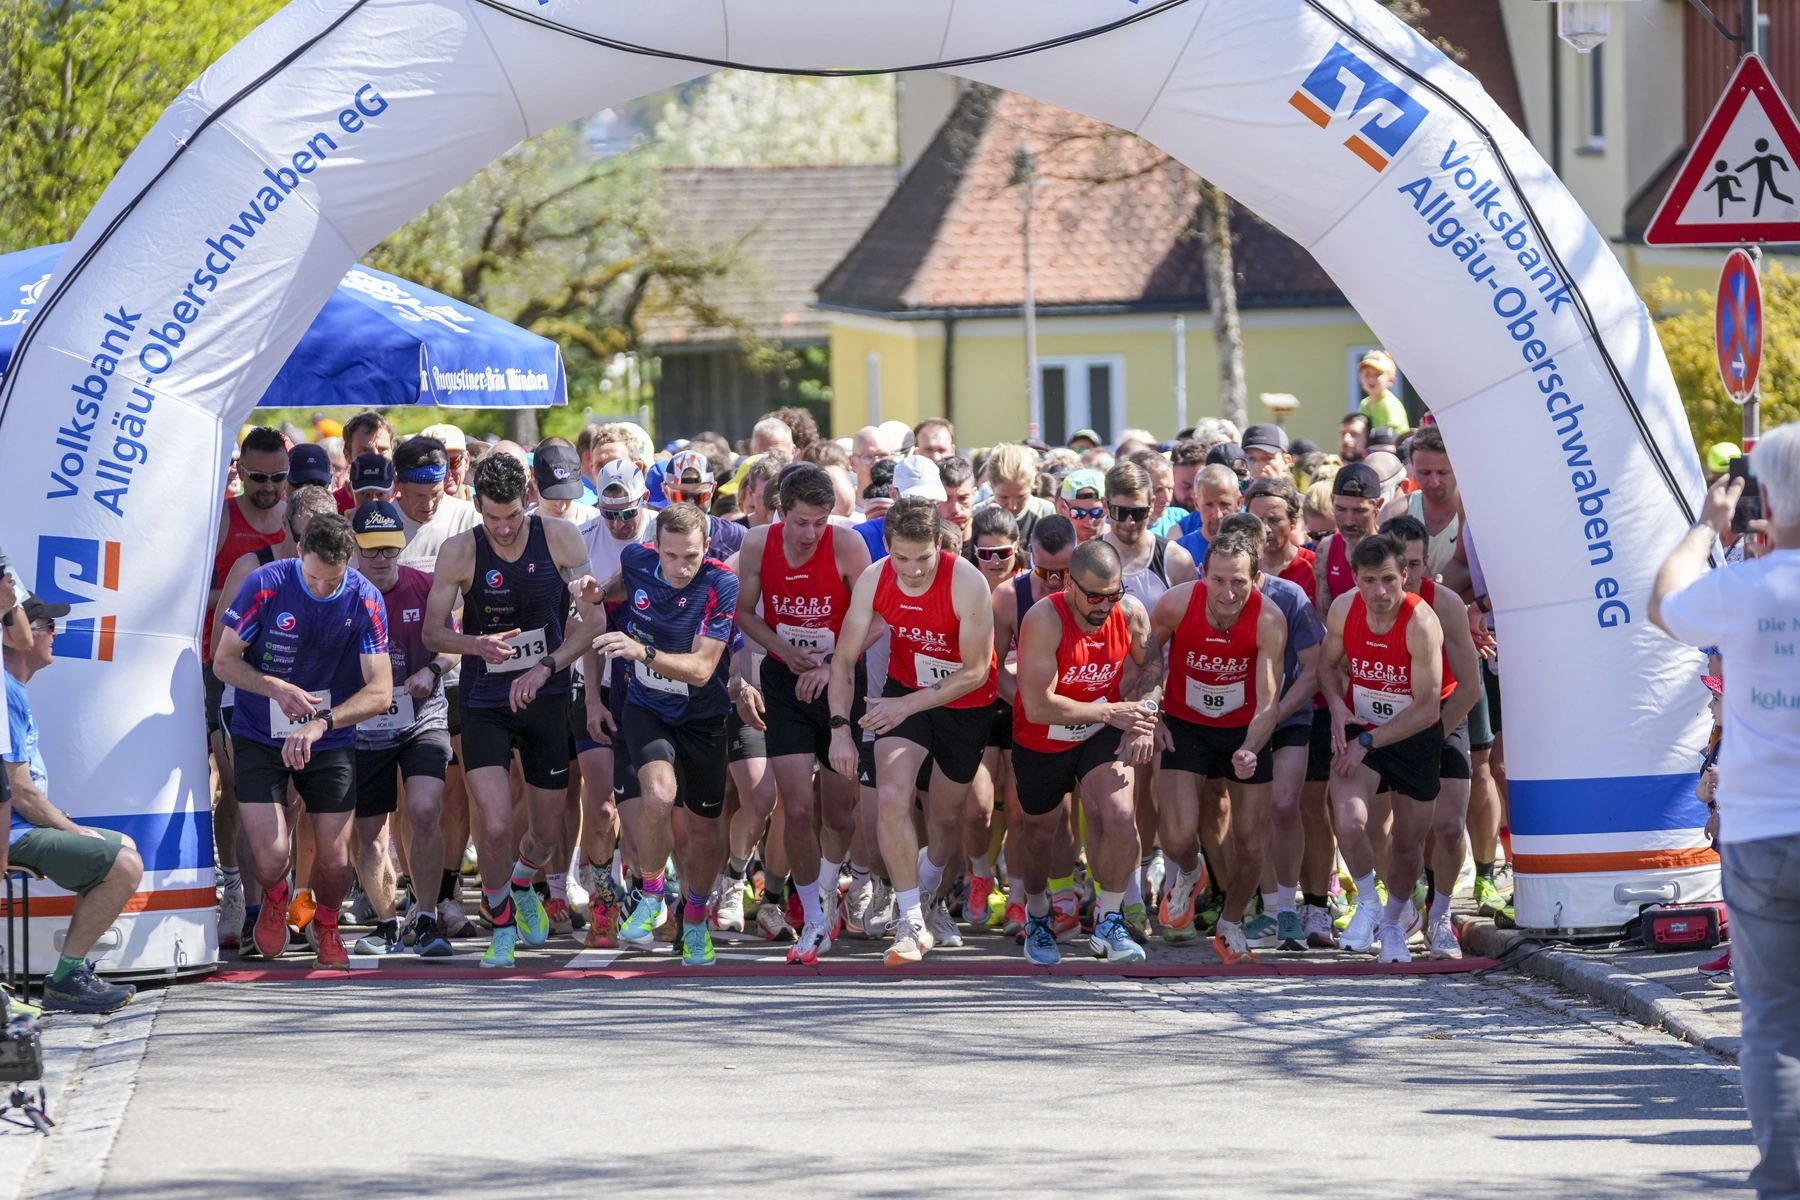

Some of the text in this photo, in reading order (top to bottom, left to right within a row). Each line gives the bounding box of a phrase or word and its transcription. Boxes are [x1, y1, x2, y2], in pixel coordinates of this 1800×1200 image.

[1438, 140, 1575, 315] Volksbank
[94, 131, 338, 517] Allgäu-Oberschwaben
[338, 83, 389, 135] eG
[47, 306, 142, 500] Volksbank
[1398, 176, 1631, 628] Allgäu-Oberschwaben eG
[772, 595, 831, 607] SPORT
[1757, 617, 1786, 632] Die
[1774, 640, 1795, 655] ist
[1186, 658, 1248, 672] HASCHKO
[1187, 651, 1250, 665] SPORT
[930, 667, 956, 678] 10
[1067, 660, 1121, 676] SPORT
[1352, 658, 1406, 675] SPORT
[1352, 667, 1407, 683] HASCHKO
[379, 700, 399, 715] 6
[1203, 694, 1225, 707] 98
[1372, 701, 1394, 716] 96
